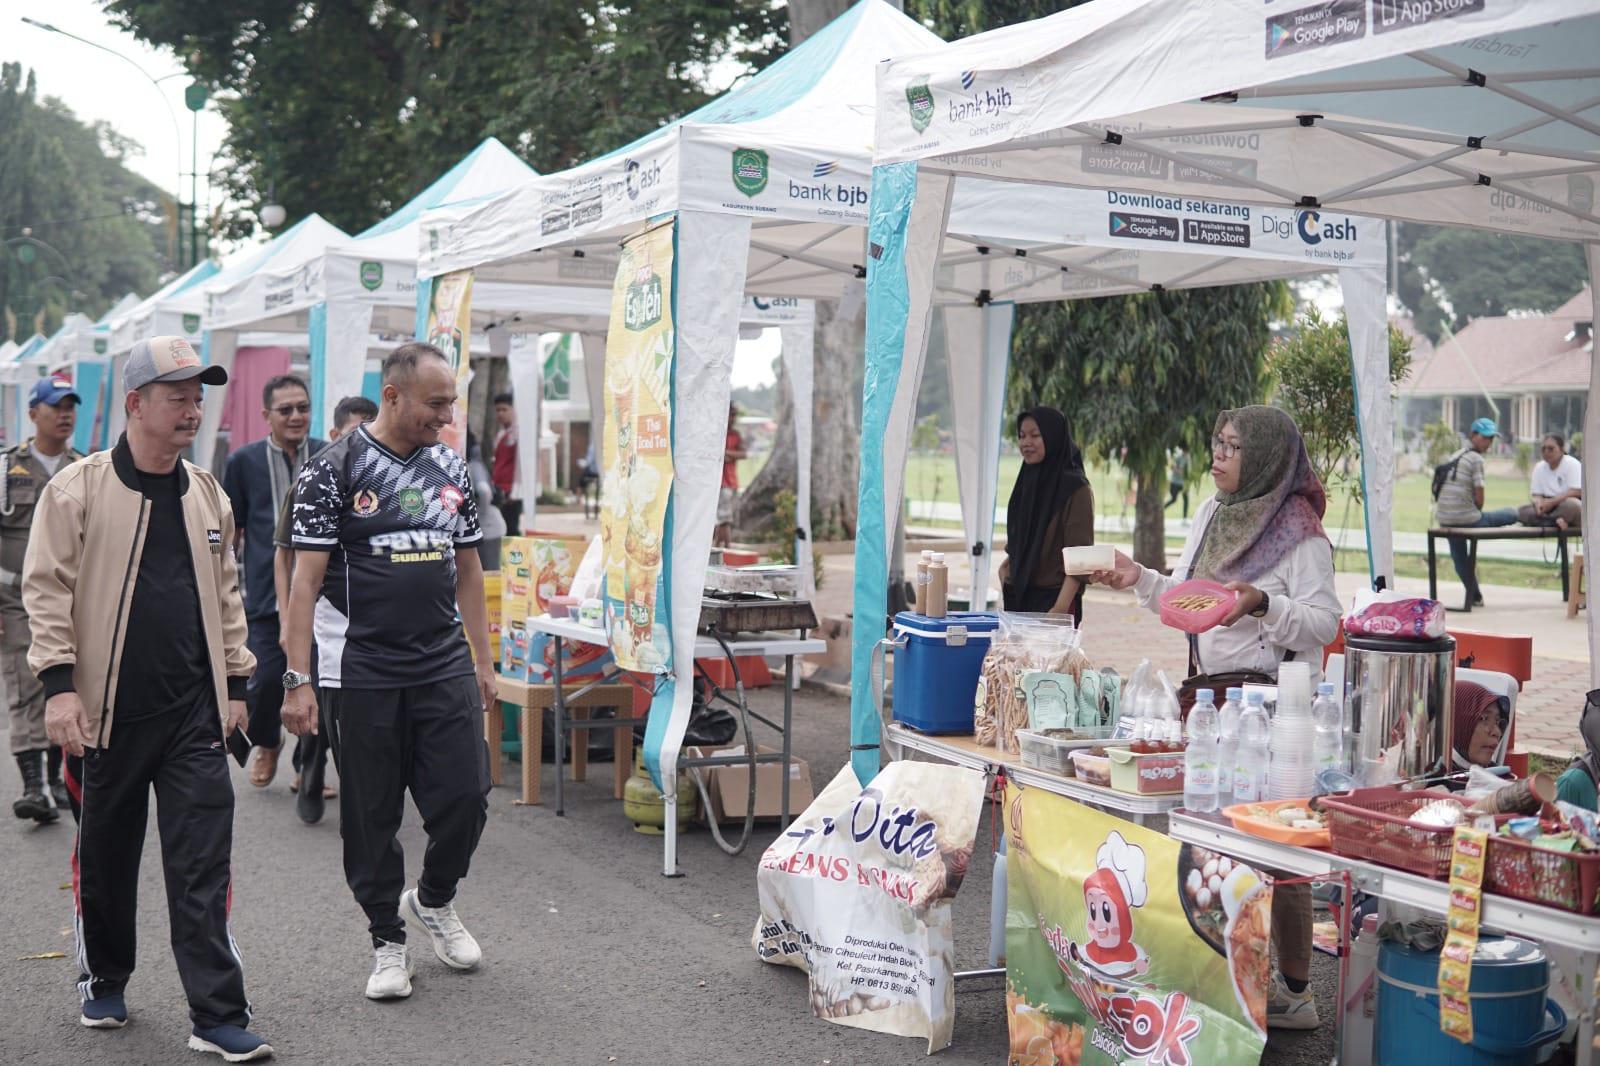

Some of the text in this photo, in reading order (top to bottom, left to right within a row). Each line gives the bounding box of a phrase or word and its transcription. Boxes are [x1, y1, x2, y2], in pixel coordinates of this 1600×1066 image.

[1294, 9, 1325, 25] TEMUKAN
[1401, 0, 1433, 23] App
[1294, 16, 1361, 43] Google Play
[949, 86, 1012, 123] bank bjb
[789, 179, 868, 207] bank bjb
[1108, 190, 1250, 221] Download sekarang
[1129, 223, 1176, 239] Google Play
[1200, 230, 1246, 244] App Store
[1314, 248, 1332, 259] bank
[1333, 249, 1348, 261] bjb
[390, 551, 443, 563] SUBANG
[844, 934, 888, 951] Diproduksi
[835, 947, 877, 961] Ciheuleut
[877, 953, 899, 965] Indah
[850, 976, 865, 987] HP.
[867, 978, 889, 990] 0813
